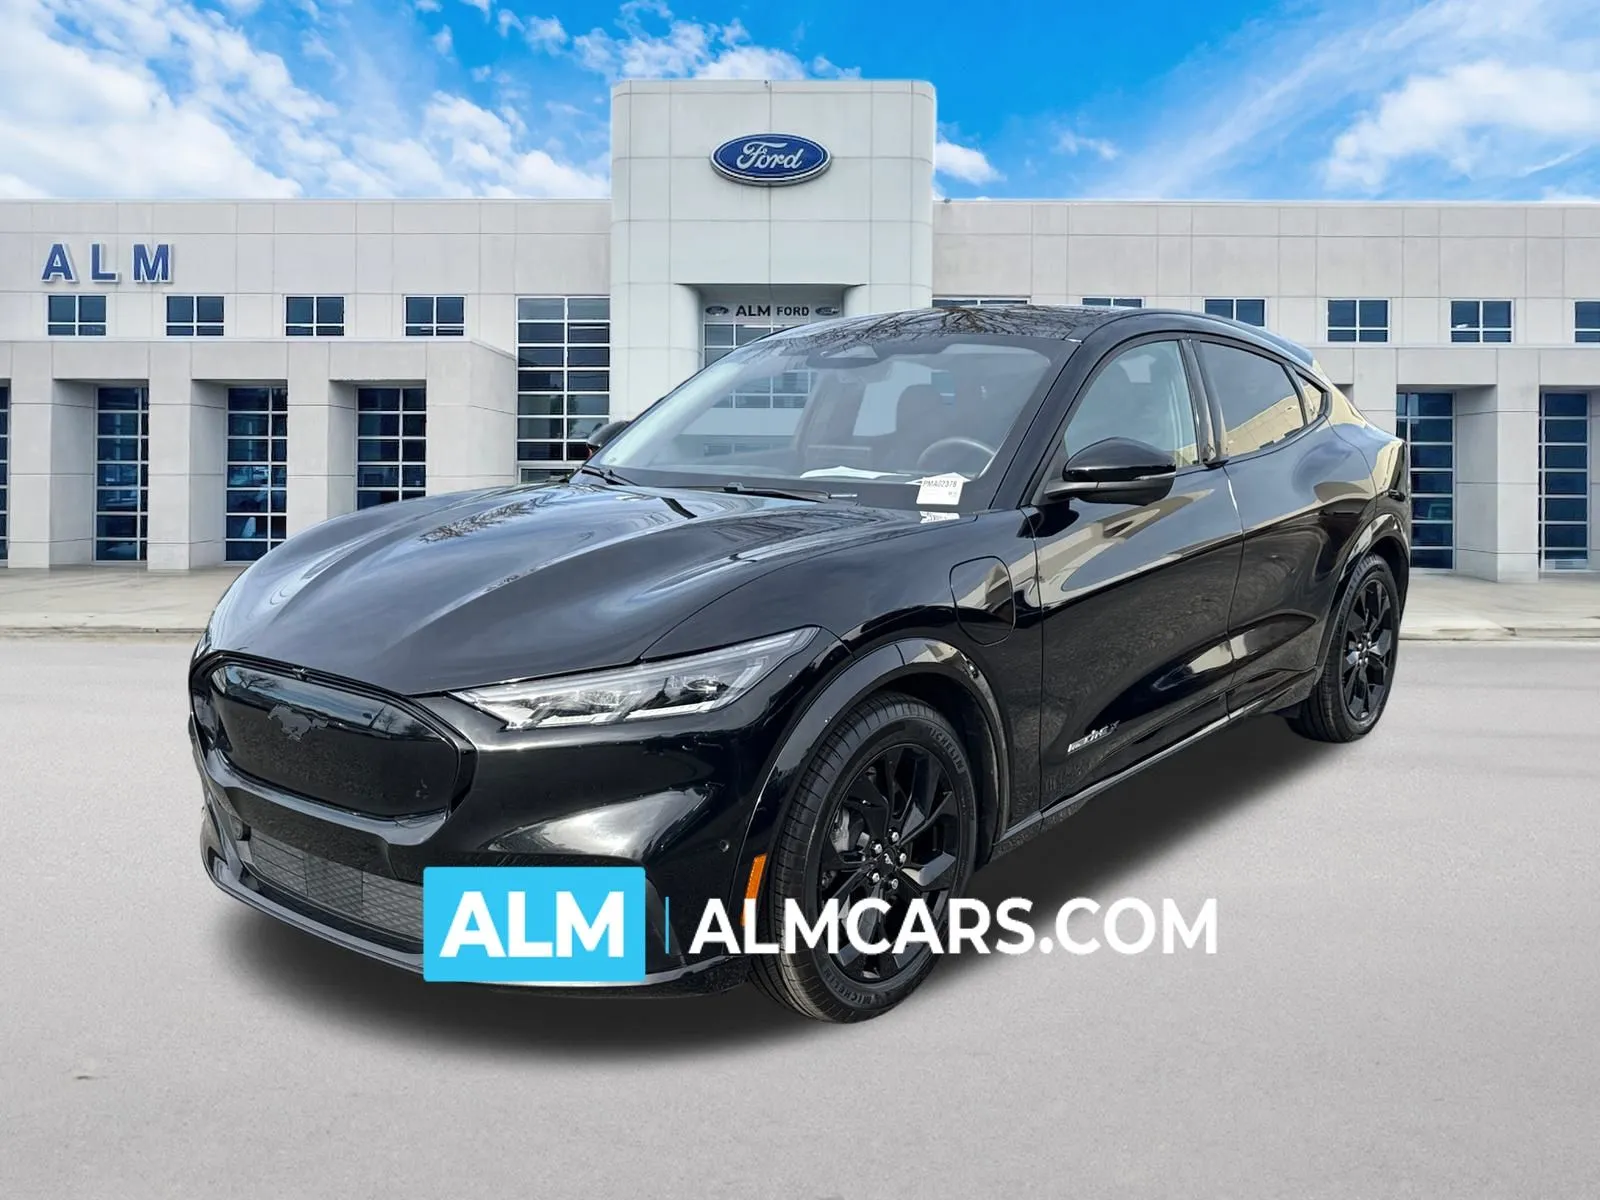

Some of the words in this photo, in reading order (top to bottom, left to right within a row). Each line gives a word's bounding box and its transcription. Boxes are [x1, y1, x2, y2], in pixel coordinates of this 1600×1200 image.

[736, 141, 805, 170] Ford
[42, 243, 172, 282] ALM
[736, 305, 771, 317] ALM
[776, 306, 809, 317] FORD
